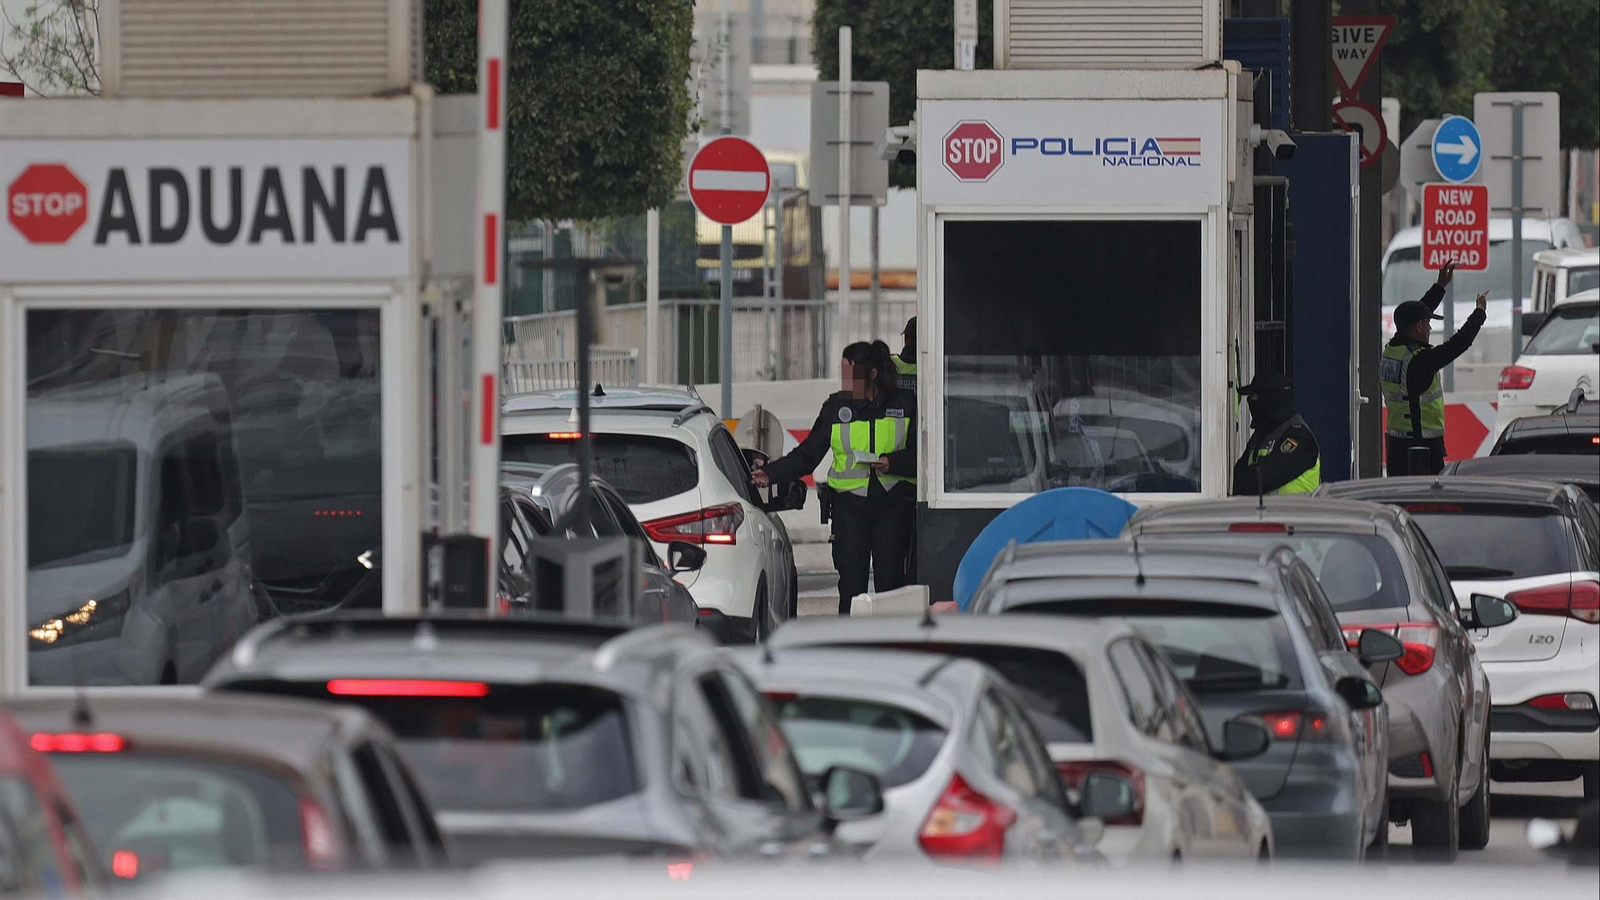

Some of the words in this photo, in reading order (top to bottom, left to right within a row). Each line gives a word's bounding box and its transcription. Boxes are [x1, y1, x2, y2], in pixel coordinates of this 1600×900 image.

[1332, 28, 1375, 44] GIVE
[1337, 49, 1367, 59] WAY
[949, 138, 998, 164] STOP
[1102, 156, 1201, 166] NACIONAL
[11, 192, 83, 216] STOP
[1438, 189, 1473, 205] NEW
[94, 166, 400, 245] ADUANA
[1434, 209, 1476, 225] ROAD
[1427, 229, 1484, 246] LAYOUT
[1428, 249, 1480, 265] AHEAD
